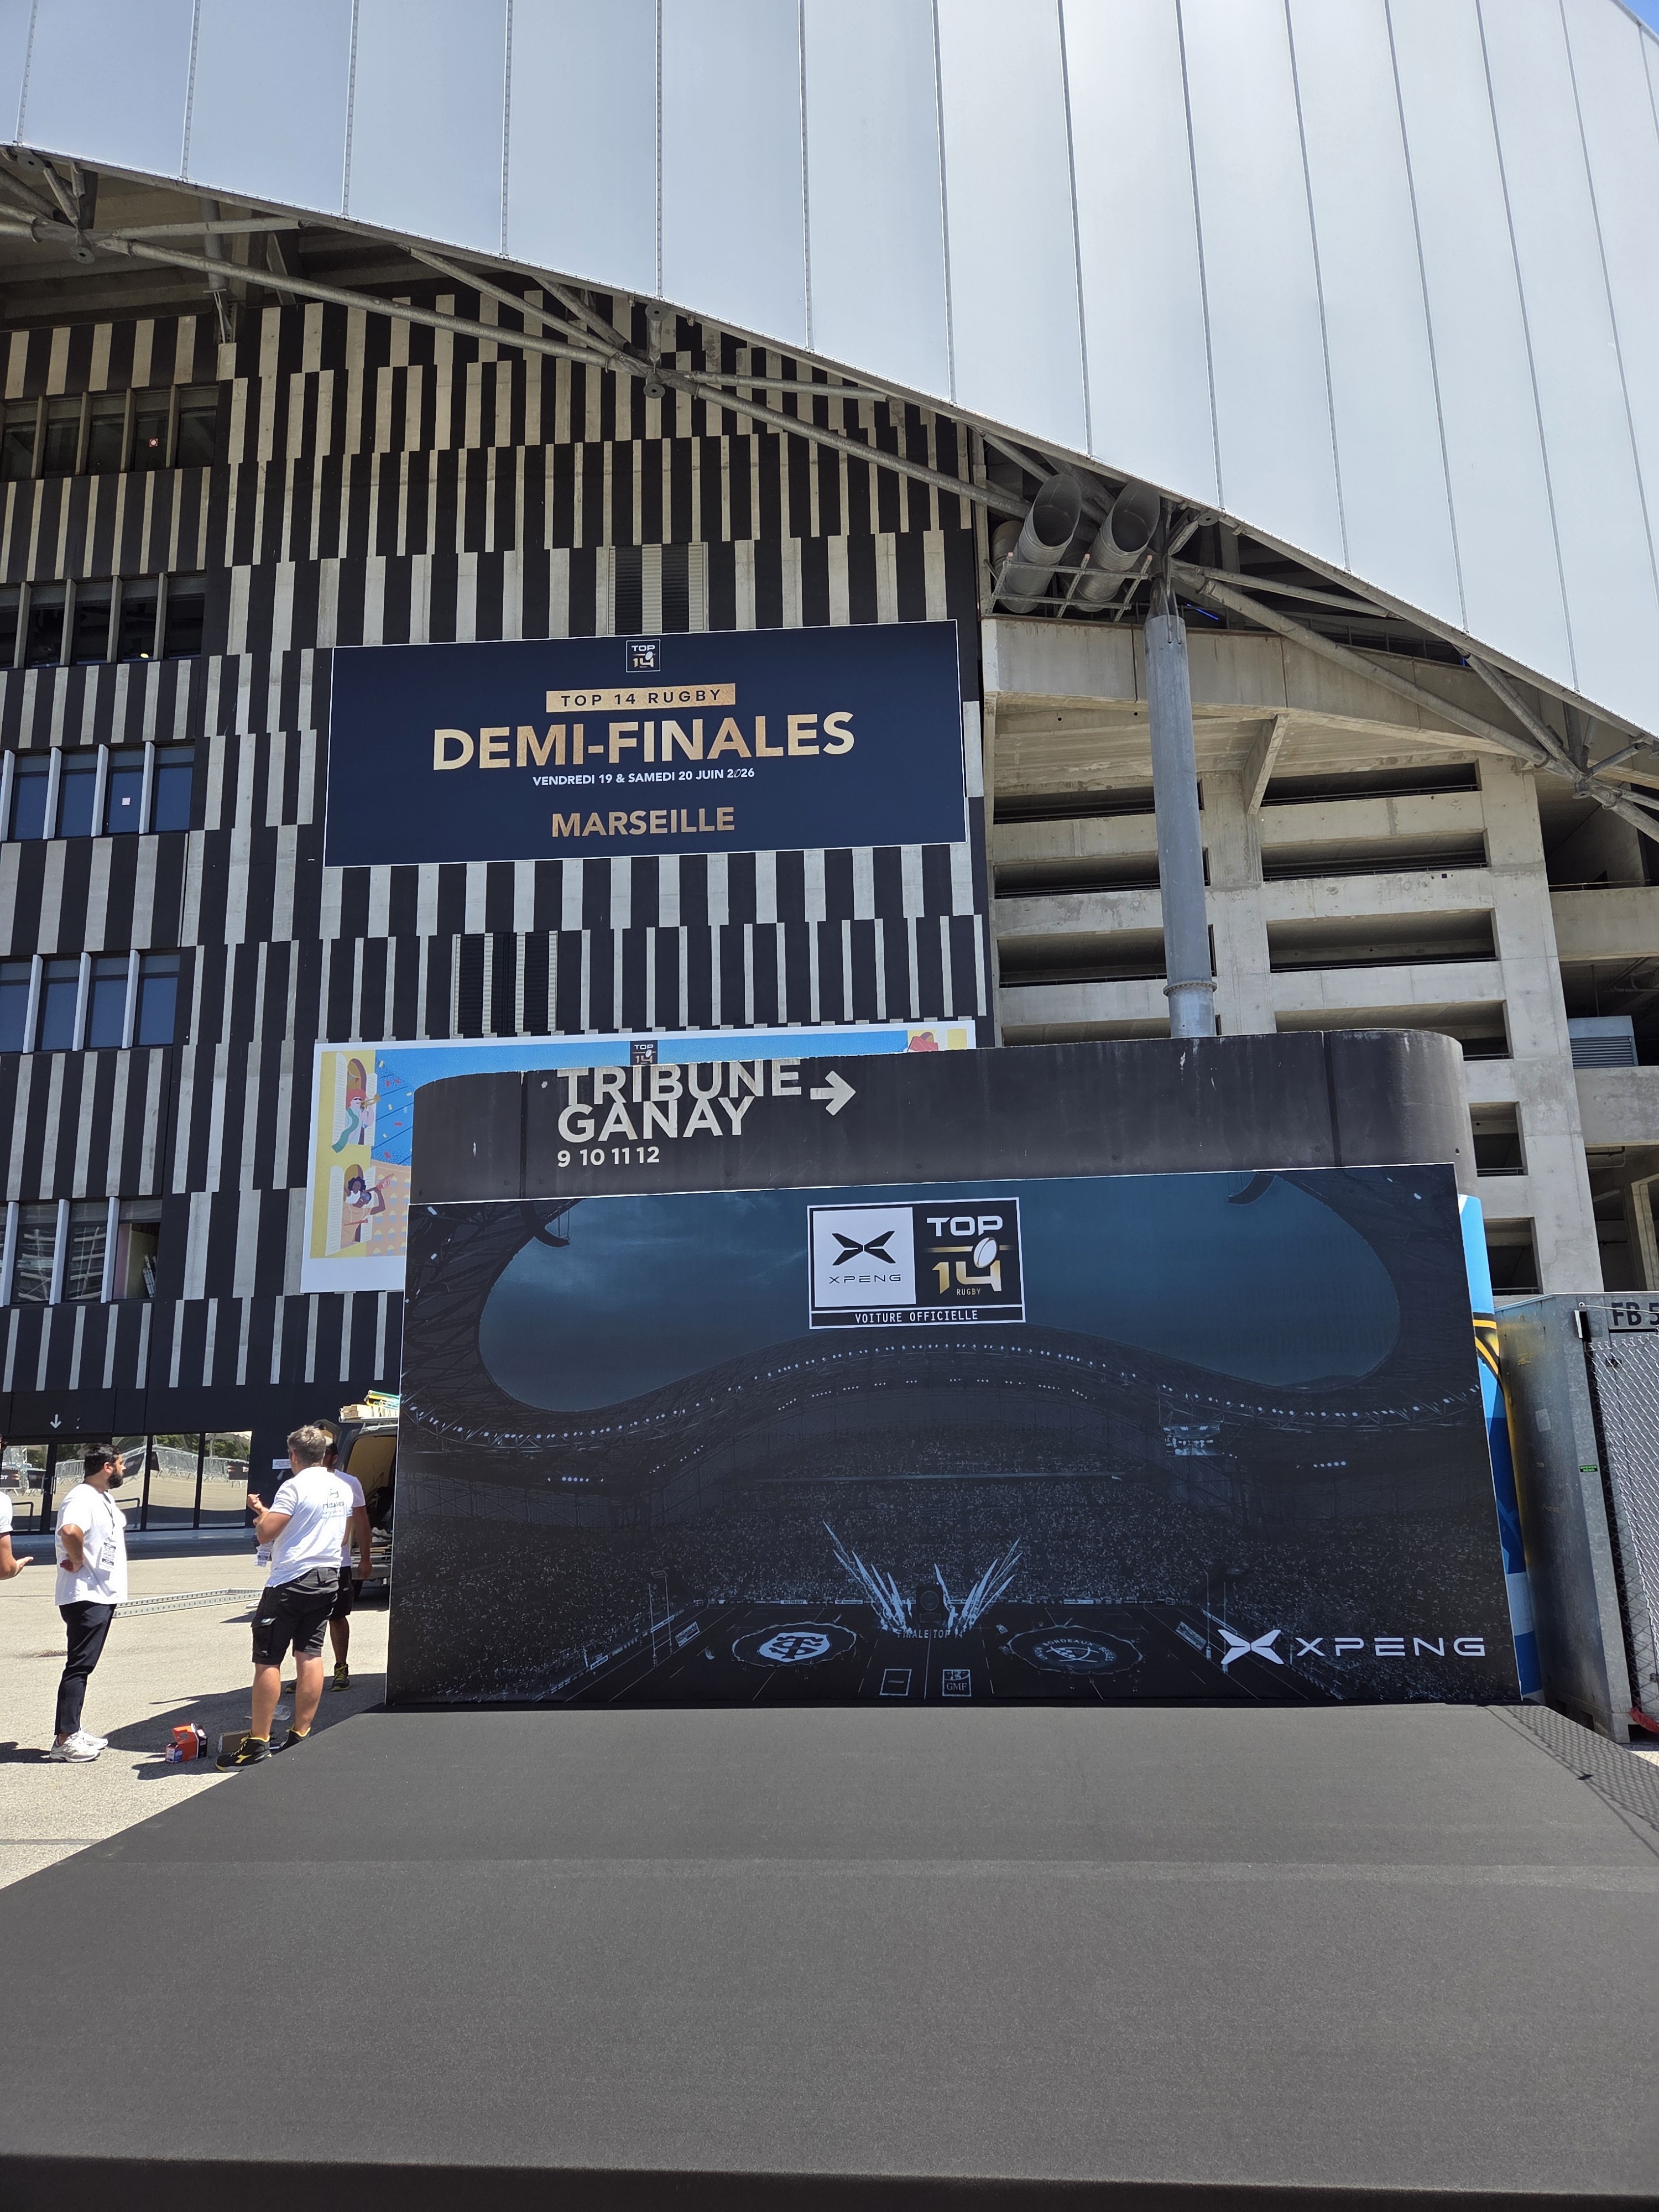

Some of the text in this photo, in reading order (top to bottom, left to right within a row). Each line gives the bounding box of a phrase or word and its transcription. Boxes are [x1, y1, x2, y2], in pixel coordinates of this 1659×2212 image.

[632, 658, 654, 667] 14
[561, 689, 721, 707] TOP 14 RUGBY
[433, 711, 855, 770] DEMI-FINALES
[533, 768, 755, 786] VENDREDI 19 & SAMEDI 20 JUIN 2026
[552, 807, 735, 837] MARSEILLE
[635, 1055, 653, 1063] 14
[556, 1058, 802, 1105] TRIBUNE
[557, 1096, 755, 1143] GANAY
[557, 1146, 660, 1167] 9 10 11 12
[926, 1215, 1003, 1237] TOP
[828, 1274, 902, 1284] XPENG
[931, 1259, 1002, 1294] 14
[854, 1310, 978, 1324] VOITURE OFFICIELLE
[1611, 1302, 1642, 1326] FB
[1041, 1638, 1093, 1647] BORDEAUX
[1295, 1637, 1486, 1657] XPENG
